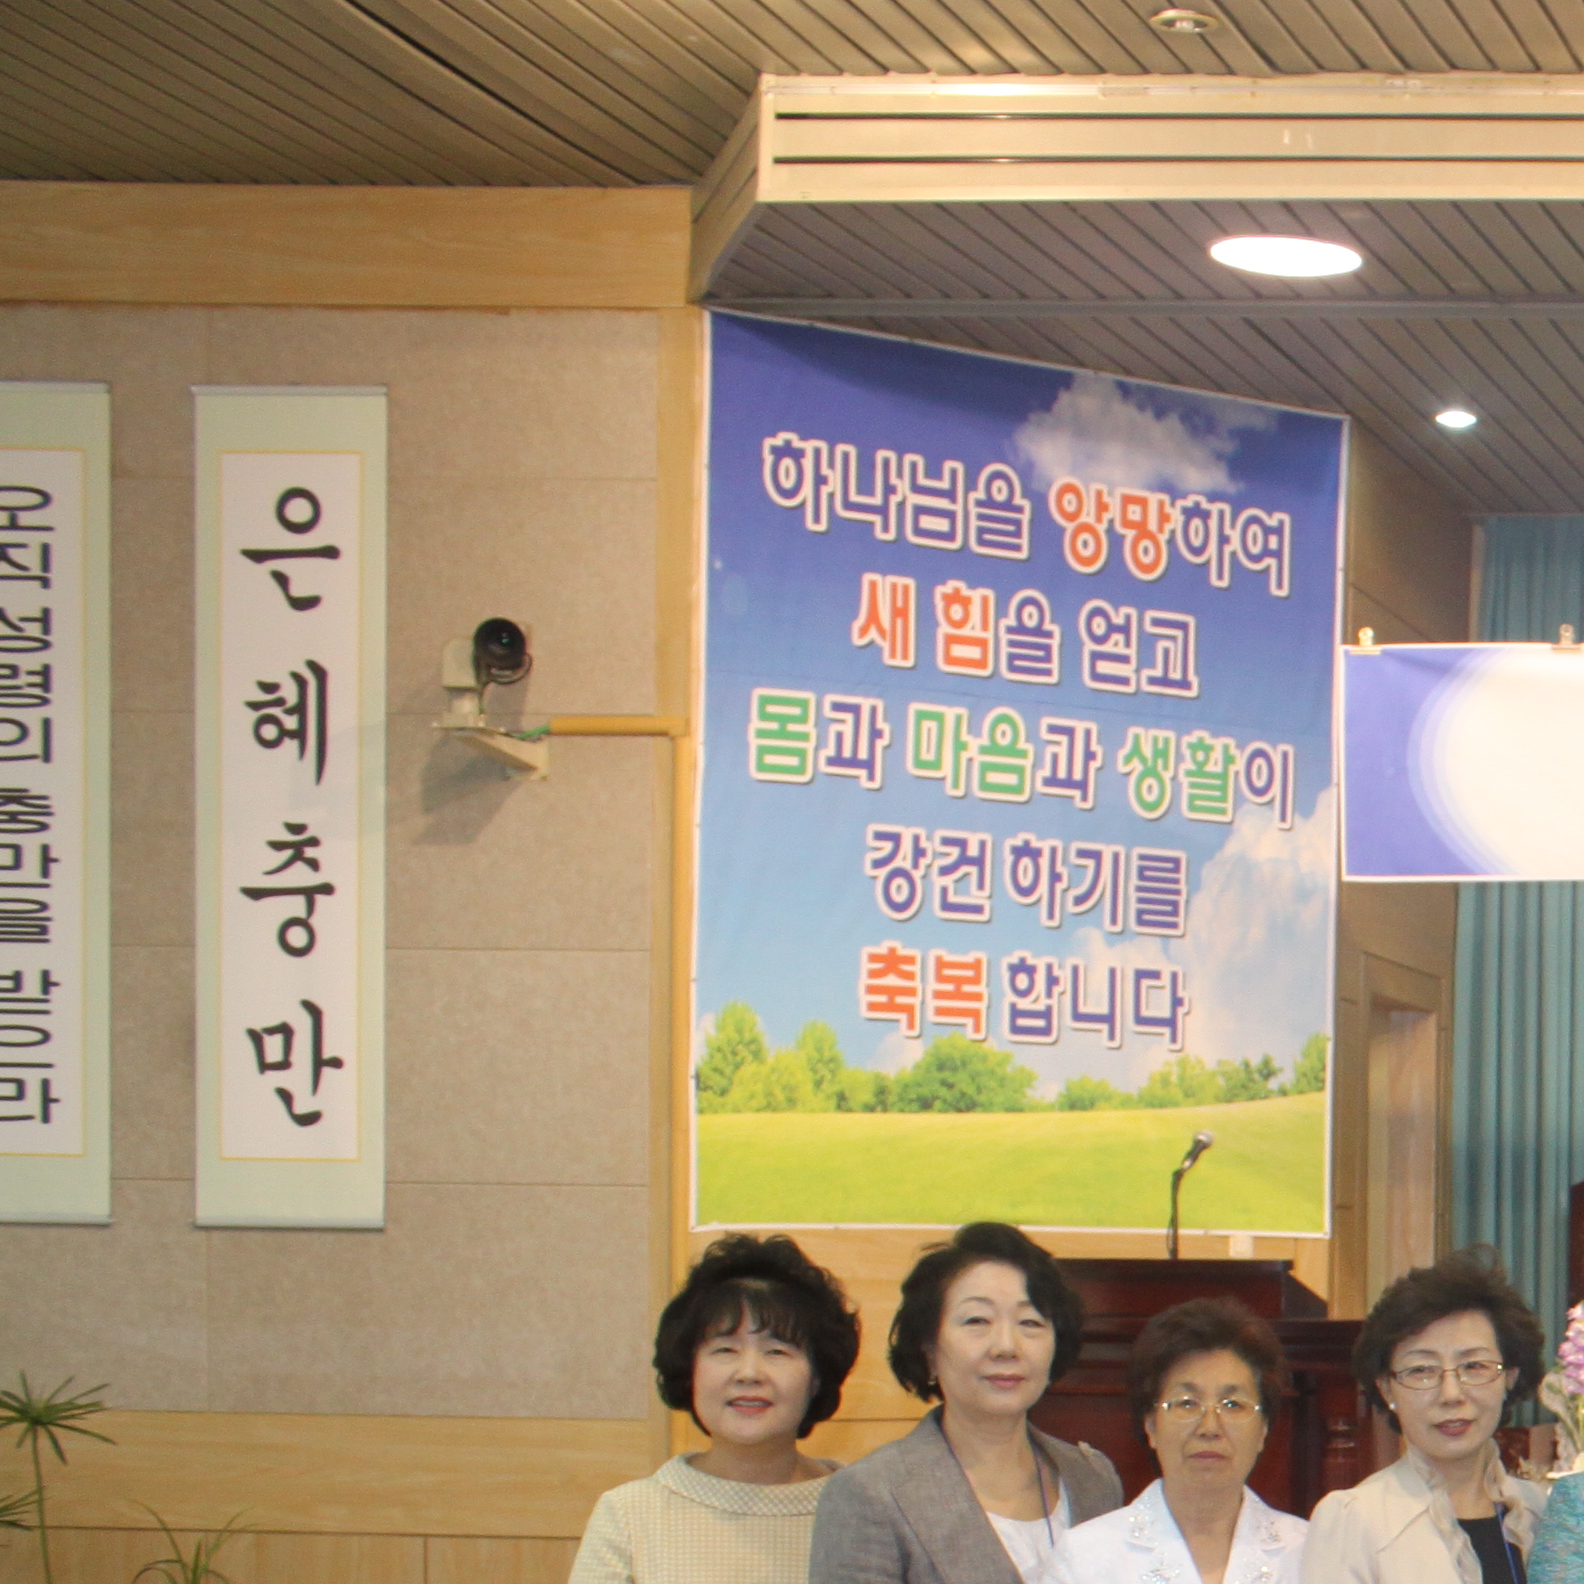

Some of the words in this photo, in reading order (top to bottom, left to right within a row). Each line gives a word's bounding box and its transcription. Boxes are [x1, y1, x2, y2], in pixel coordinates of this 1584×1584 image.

[762, 433, 1031, 560] 하나님을
[1049, 478, 1291, 596] 앙망하여
[852, 573, 917, 669] 새
[936, 580, 1061, 685] 힘을
[1079, 598, 1199, 699] 얻고
[750, 687, 889, 788] 몸과
[906, 701, 1101, 809] 마음과
[1118, 725, 1294, 830] 생활이
